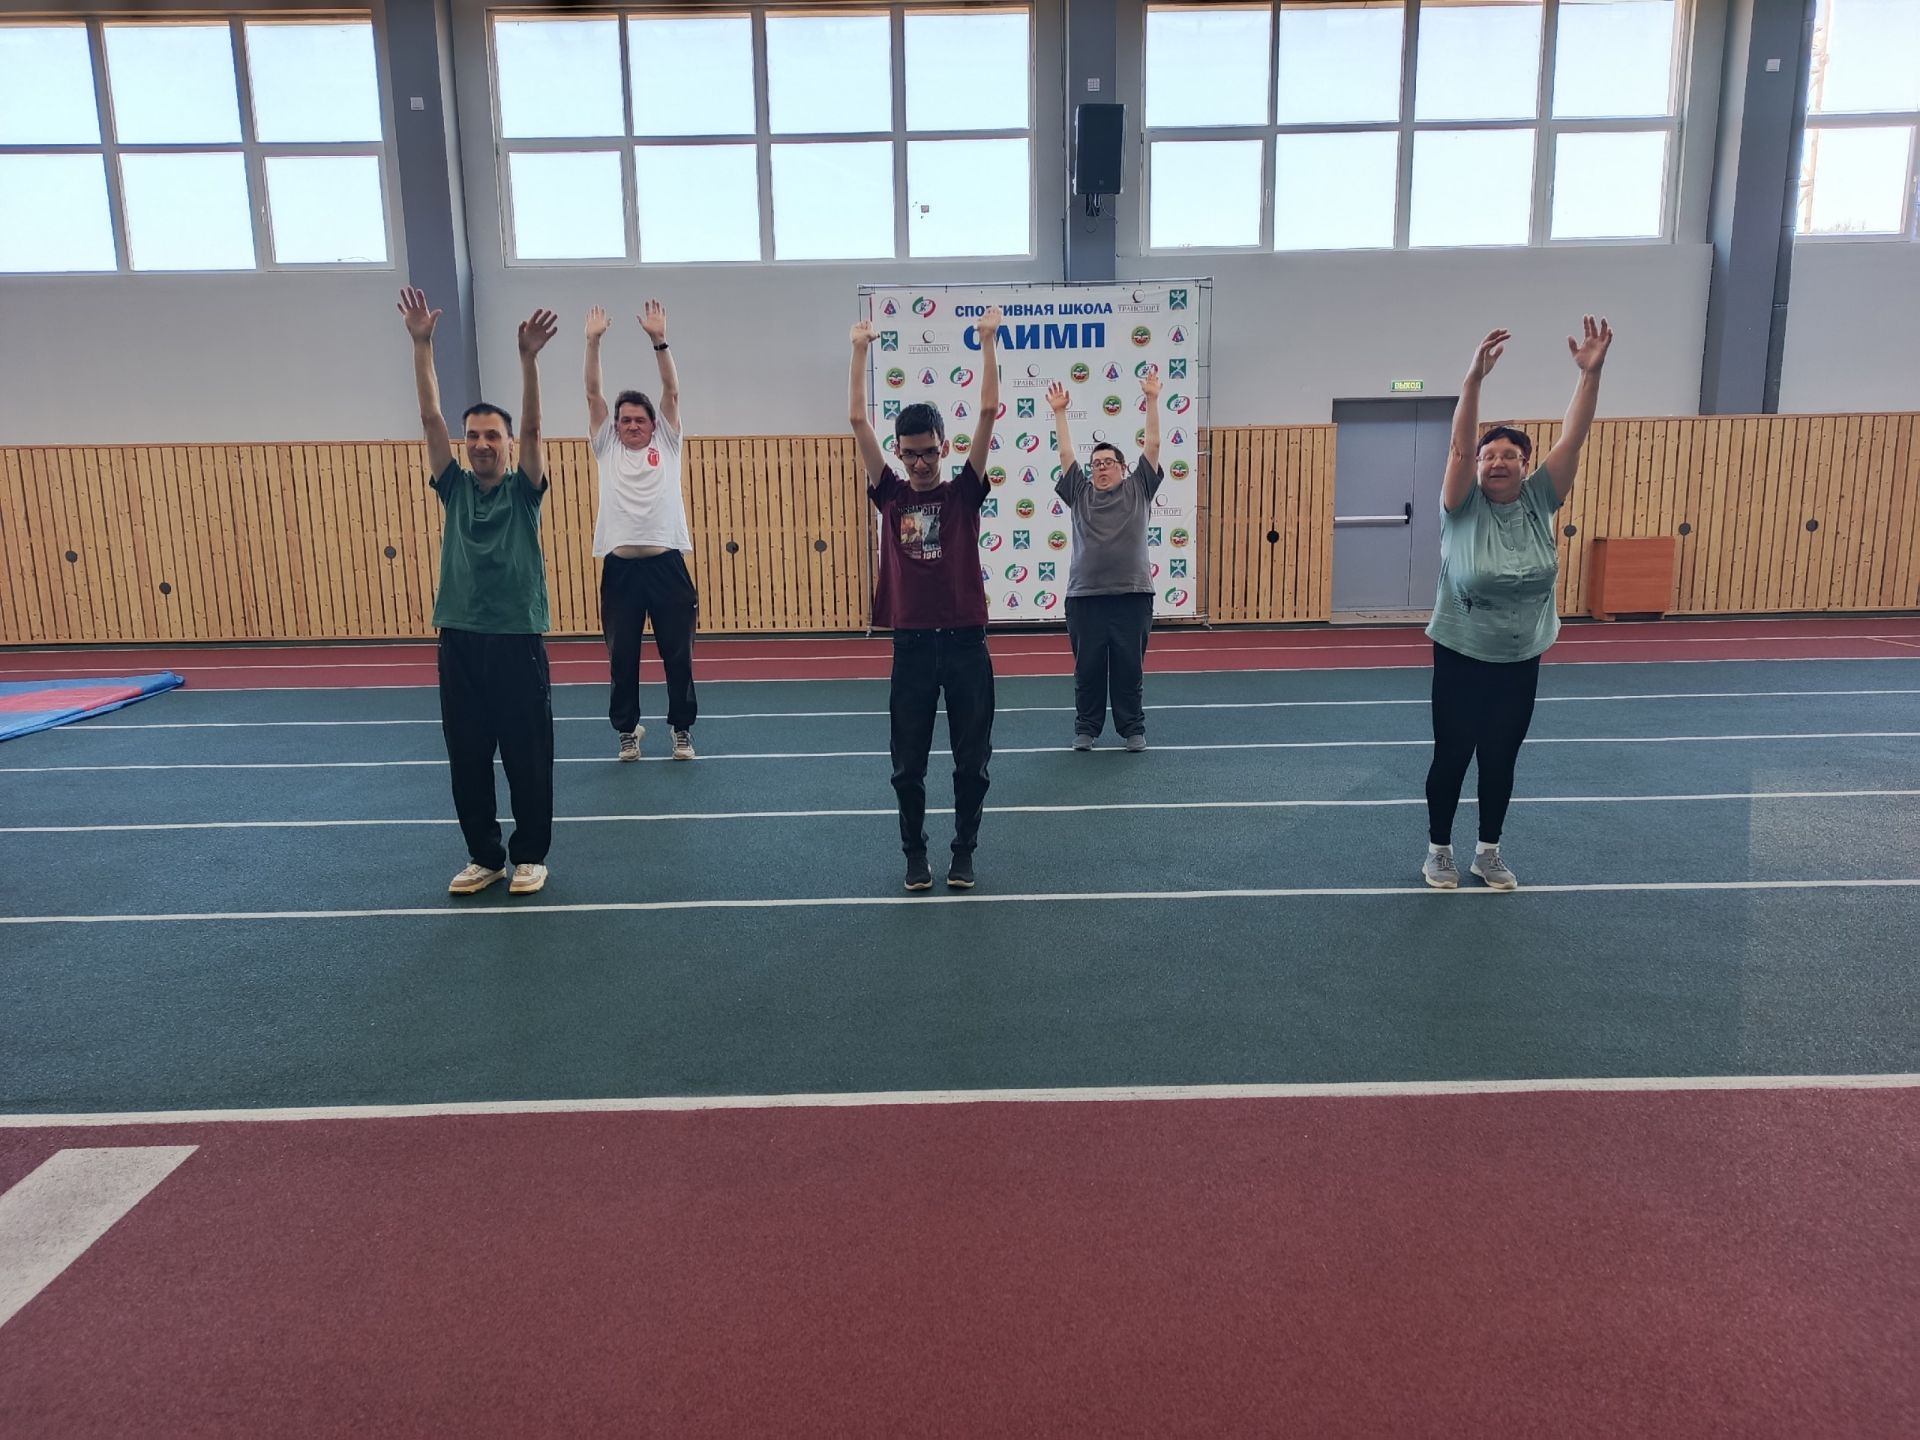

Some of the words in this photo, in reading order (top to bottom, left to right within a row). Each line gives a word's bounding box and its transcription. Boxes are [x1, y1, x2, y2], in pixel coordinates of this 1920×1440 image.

[955, 304, 1054, 317] СПОИВНАЯ
[1059, 302, 1113, 315] ШКОЛА
[922, 505, 942, 515] CITY
